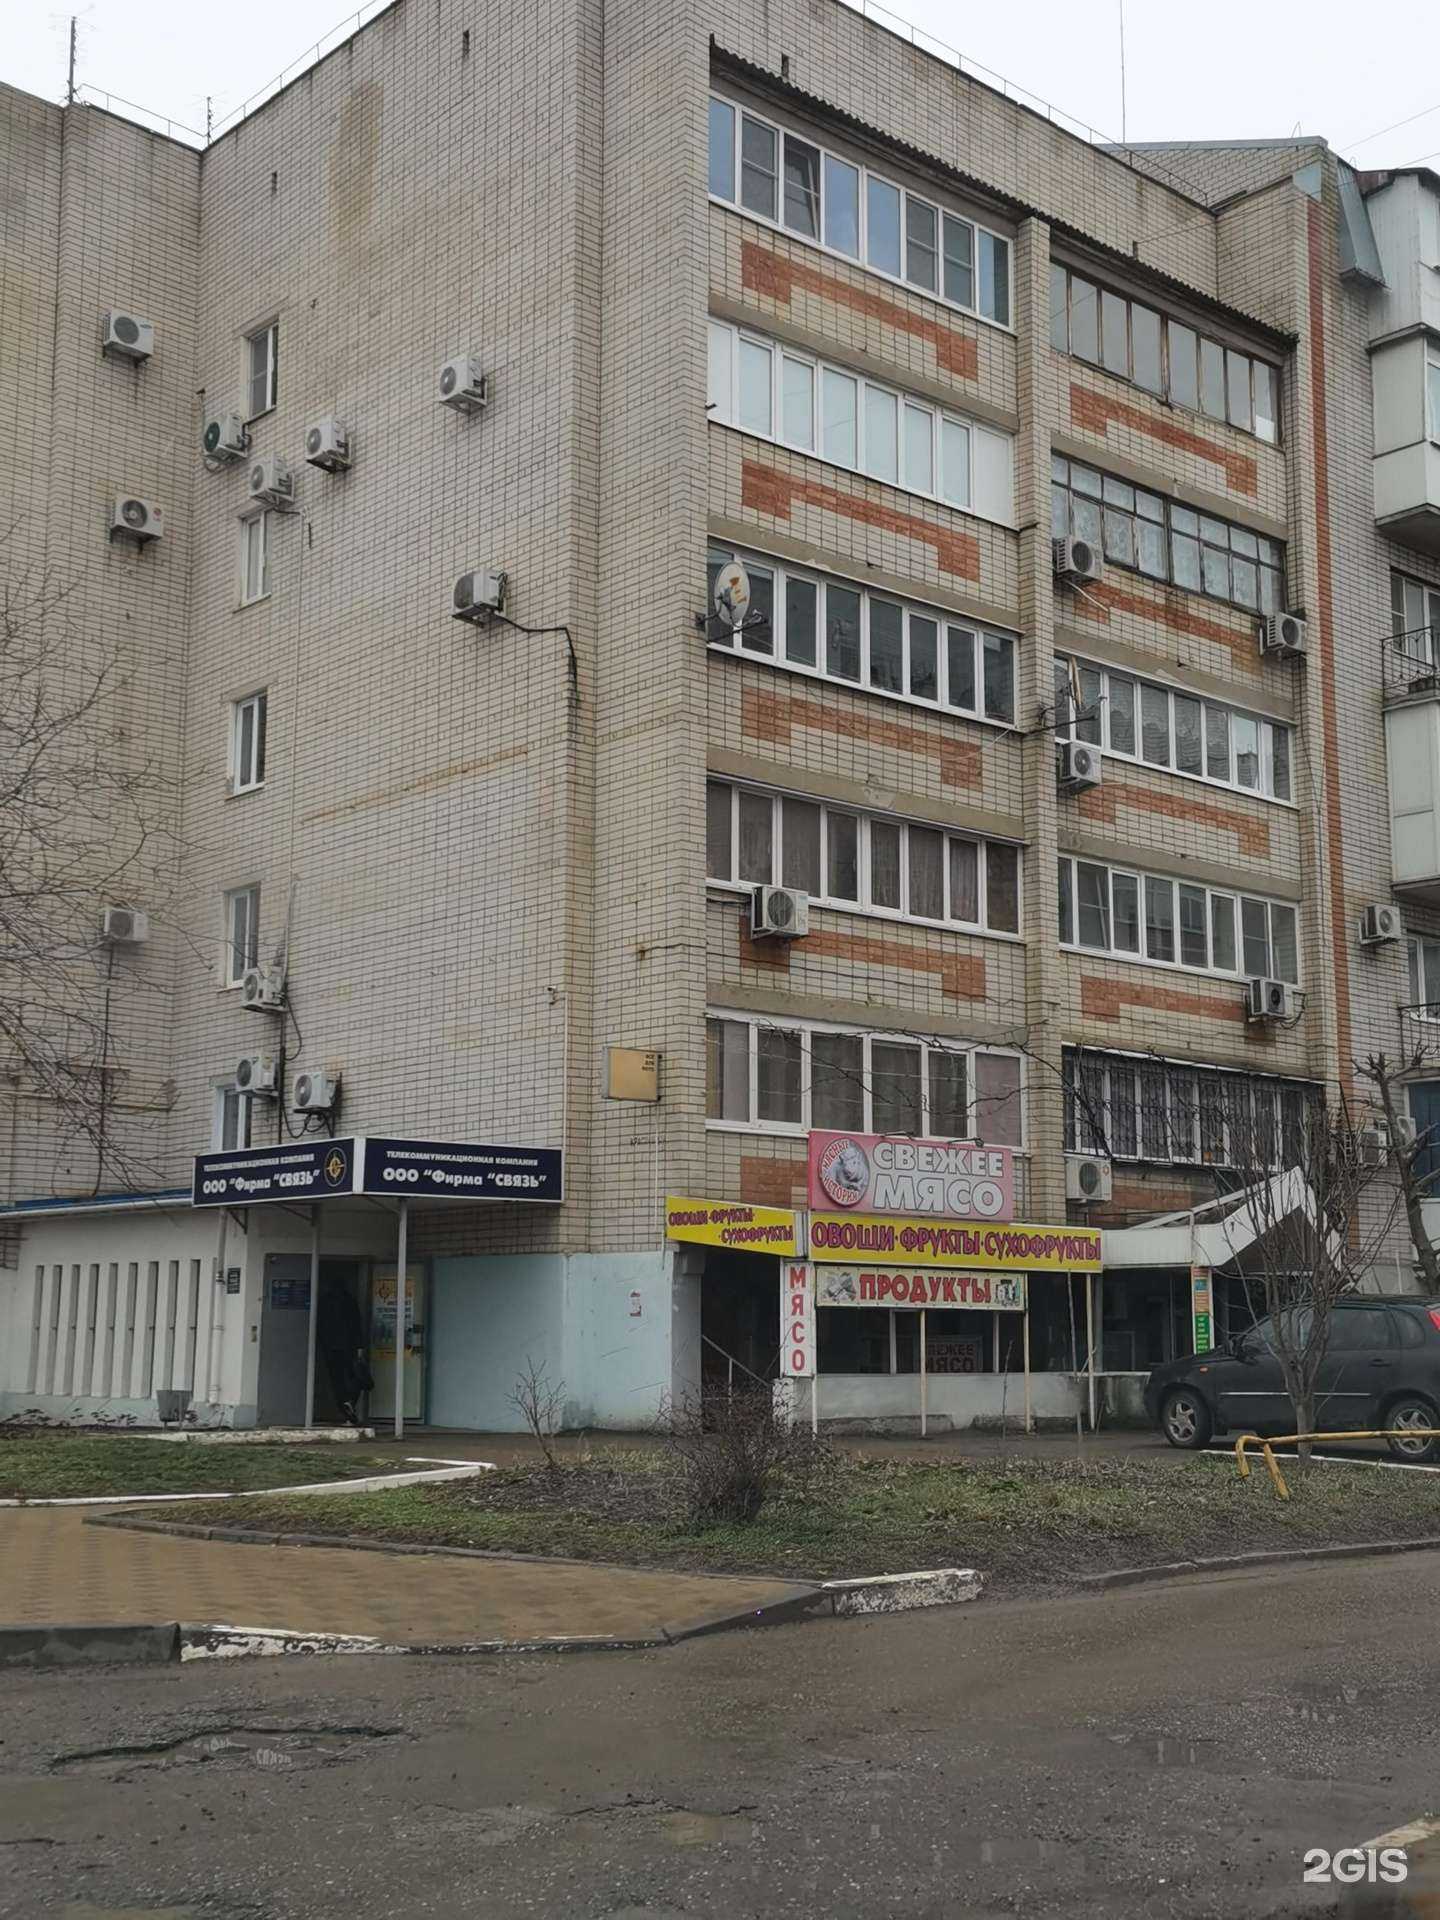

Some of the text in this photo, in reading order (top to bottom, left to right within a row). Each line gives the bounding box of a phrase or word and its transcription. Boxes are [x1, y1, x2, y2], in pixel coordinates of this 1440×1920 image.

[382, 1167, 419, 1182] ООО
[386, 1150, 538, 1167] ТЕЛЕКОММУНИКАЦИОННАЯ КОМПАНИЯ
[873, 1142, 1003, 1177] СВЕЖЕЕ
[203, 1179, 227, 1194] ООО
[873, 1173, 1004, 1216] МЯСО
[811, 1222, 894, 1252] ОВОЩИ
[984, 1231, 1101, 1263] СУХОФРУКТЫ
[858, 1273, 992, 1303] ПРОДУКТЫ
[790, 1266, 806, 1372] МЯСО
